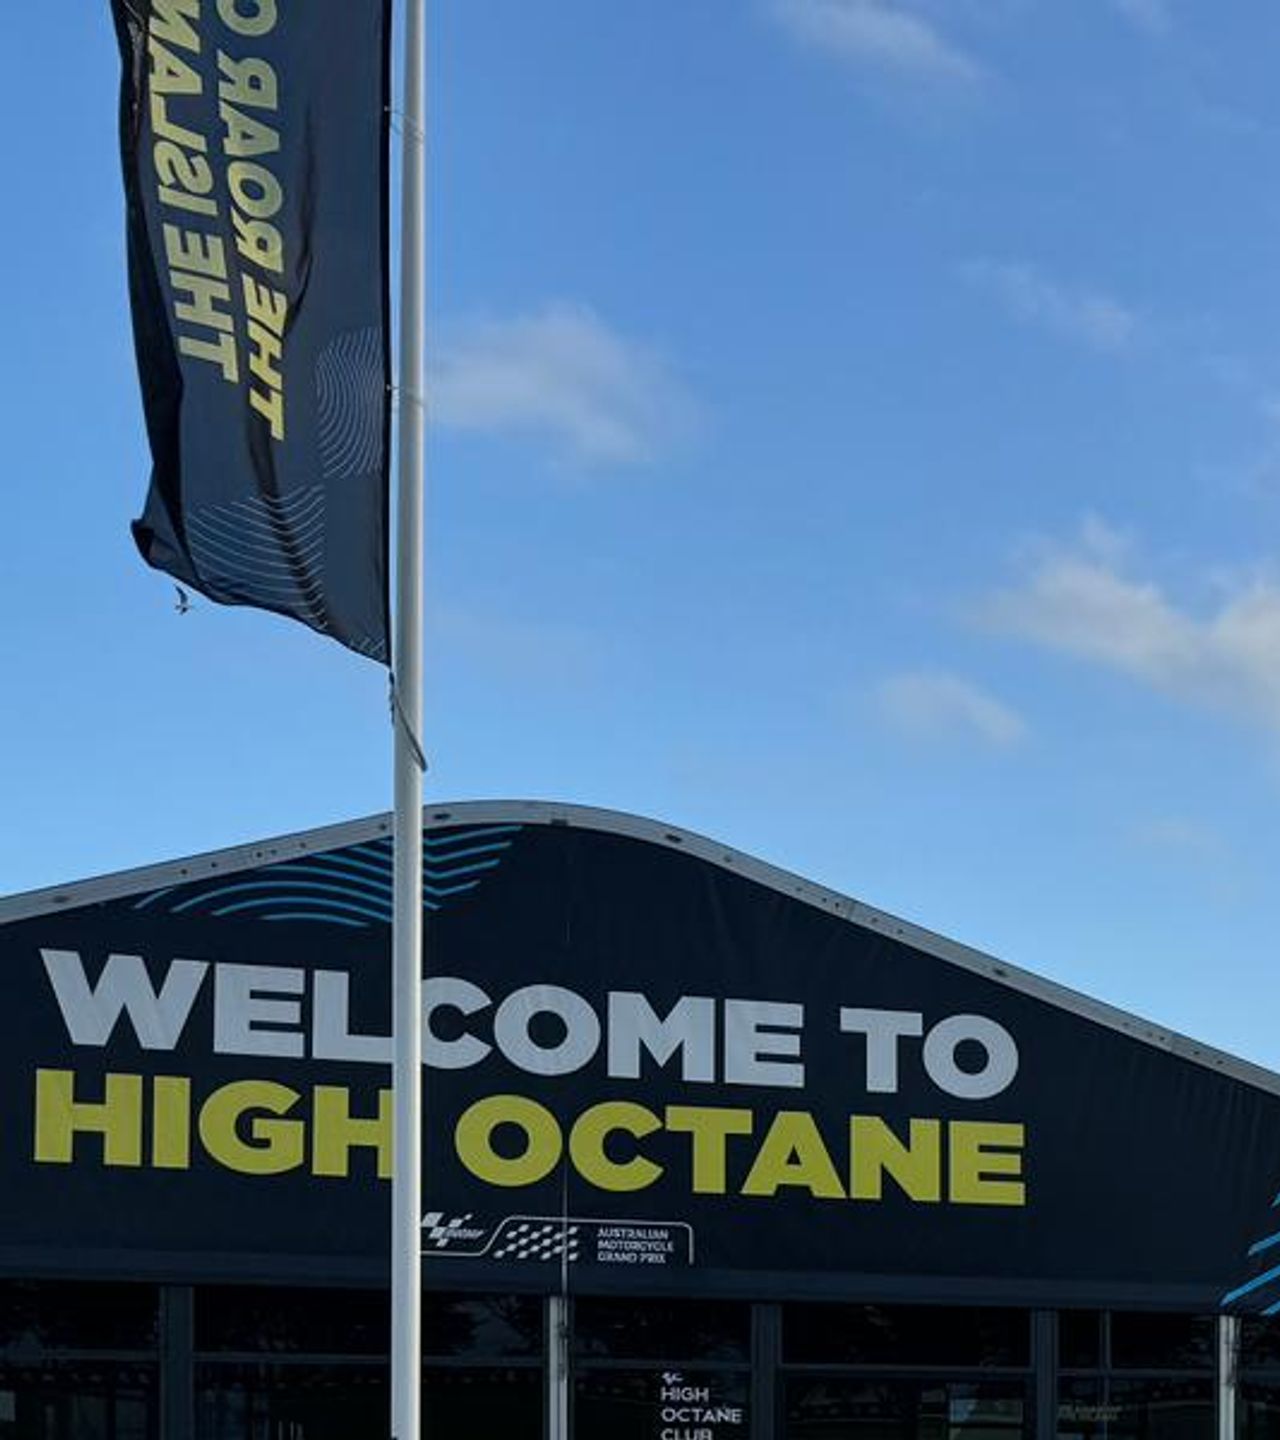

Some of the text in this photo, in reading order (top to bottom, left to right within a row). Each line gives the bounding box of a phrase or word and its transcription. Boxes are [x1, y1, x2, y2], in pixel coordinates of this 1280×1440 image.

[40, 948, 1020, 1100] WELCOME TO
[34, 1068, 1026, 1206] HIGH OCTANE
[597, 1229, 669, 1240] AUSTRALIAN
[597, 1240, 674, 1251] MOTORCYCLE
[597, 1252, 666, 1264] GRAND PRIX
[660, 1387, 709, 1402] HIGH
[660, 1408, 742, 1424] OCTANE
